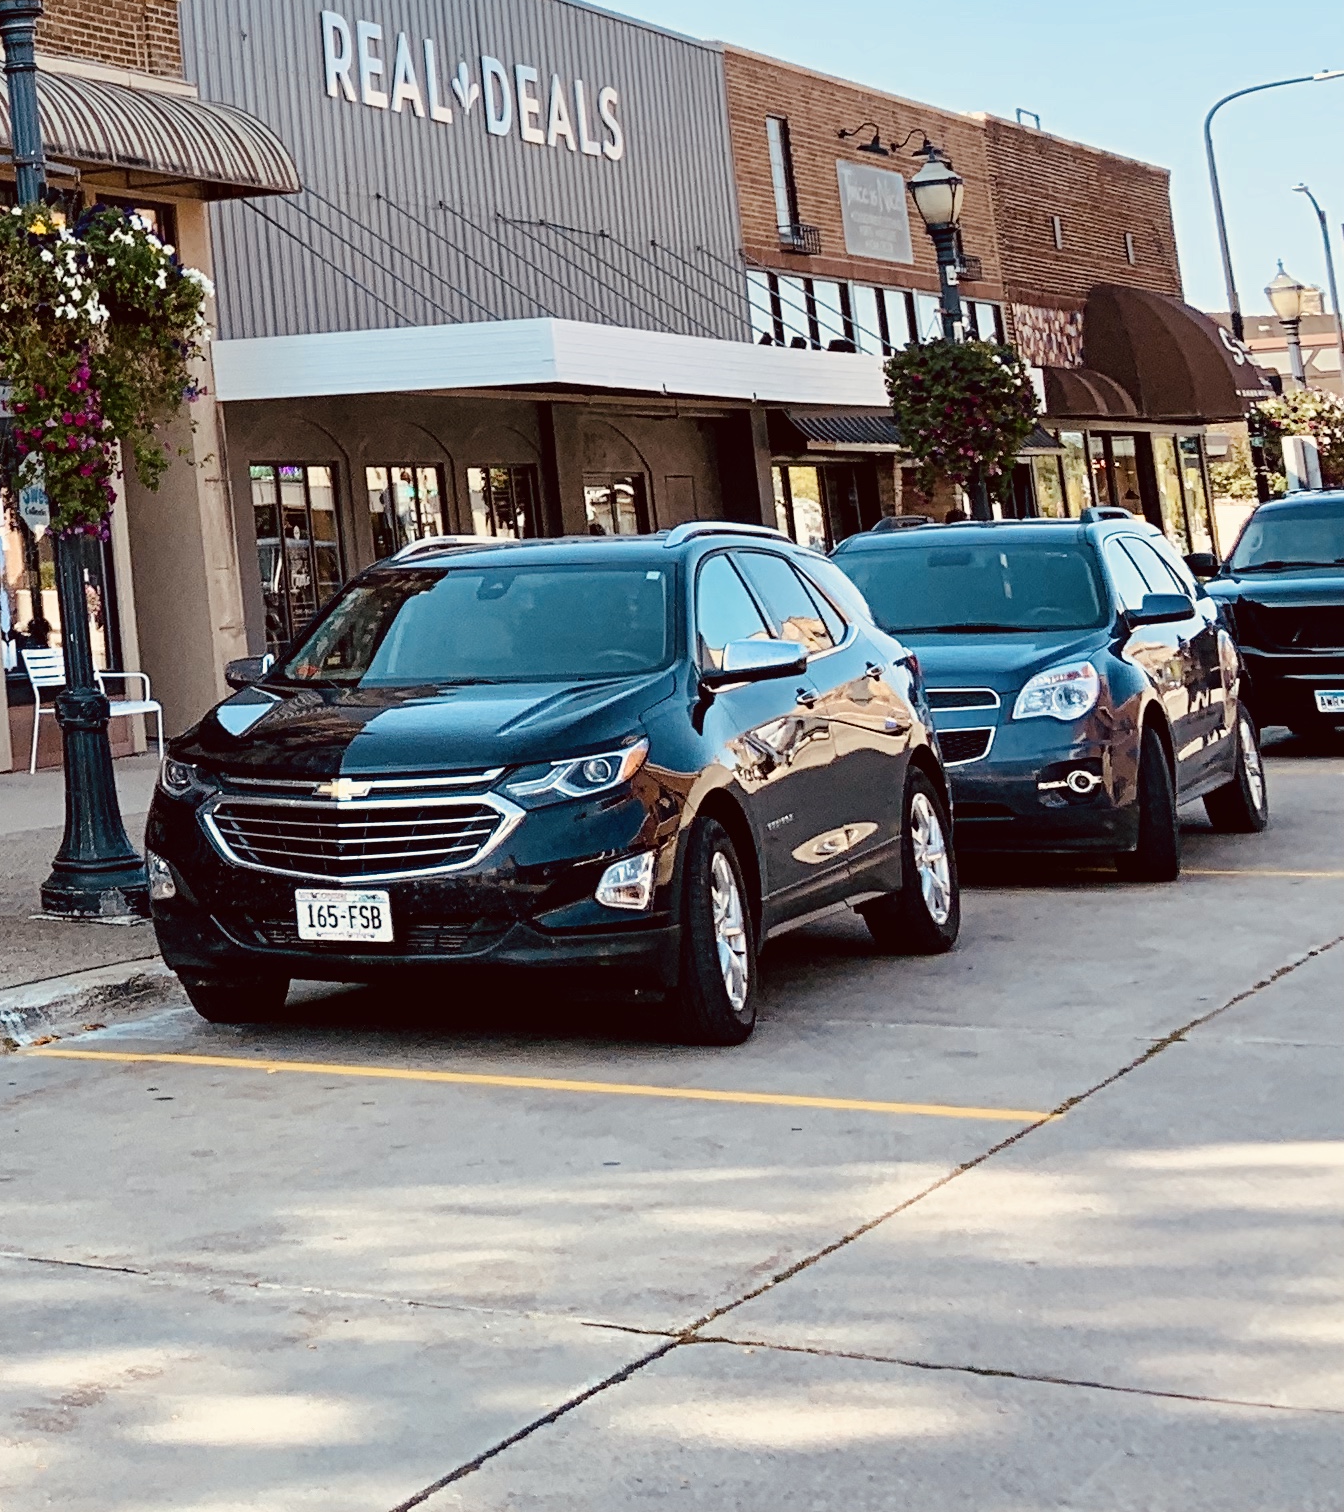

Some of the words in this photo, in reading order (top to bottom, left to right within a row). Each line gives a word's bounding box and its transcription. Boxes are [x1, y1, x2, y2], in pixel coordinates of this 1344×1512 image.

[321, 9, 454, 125] REAL
[480, 56, 625, 162] DEALS
[307, 904, 382, 929] 165-FSB
